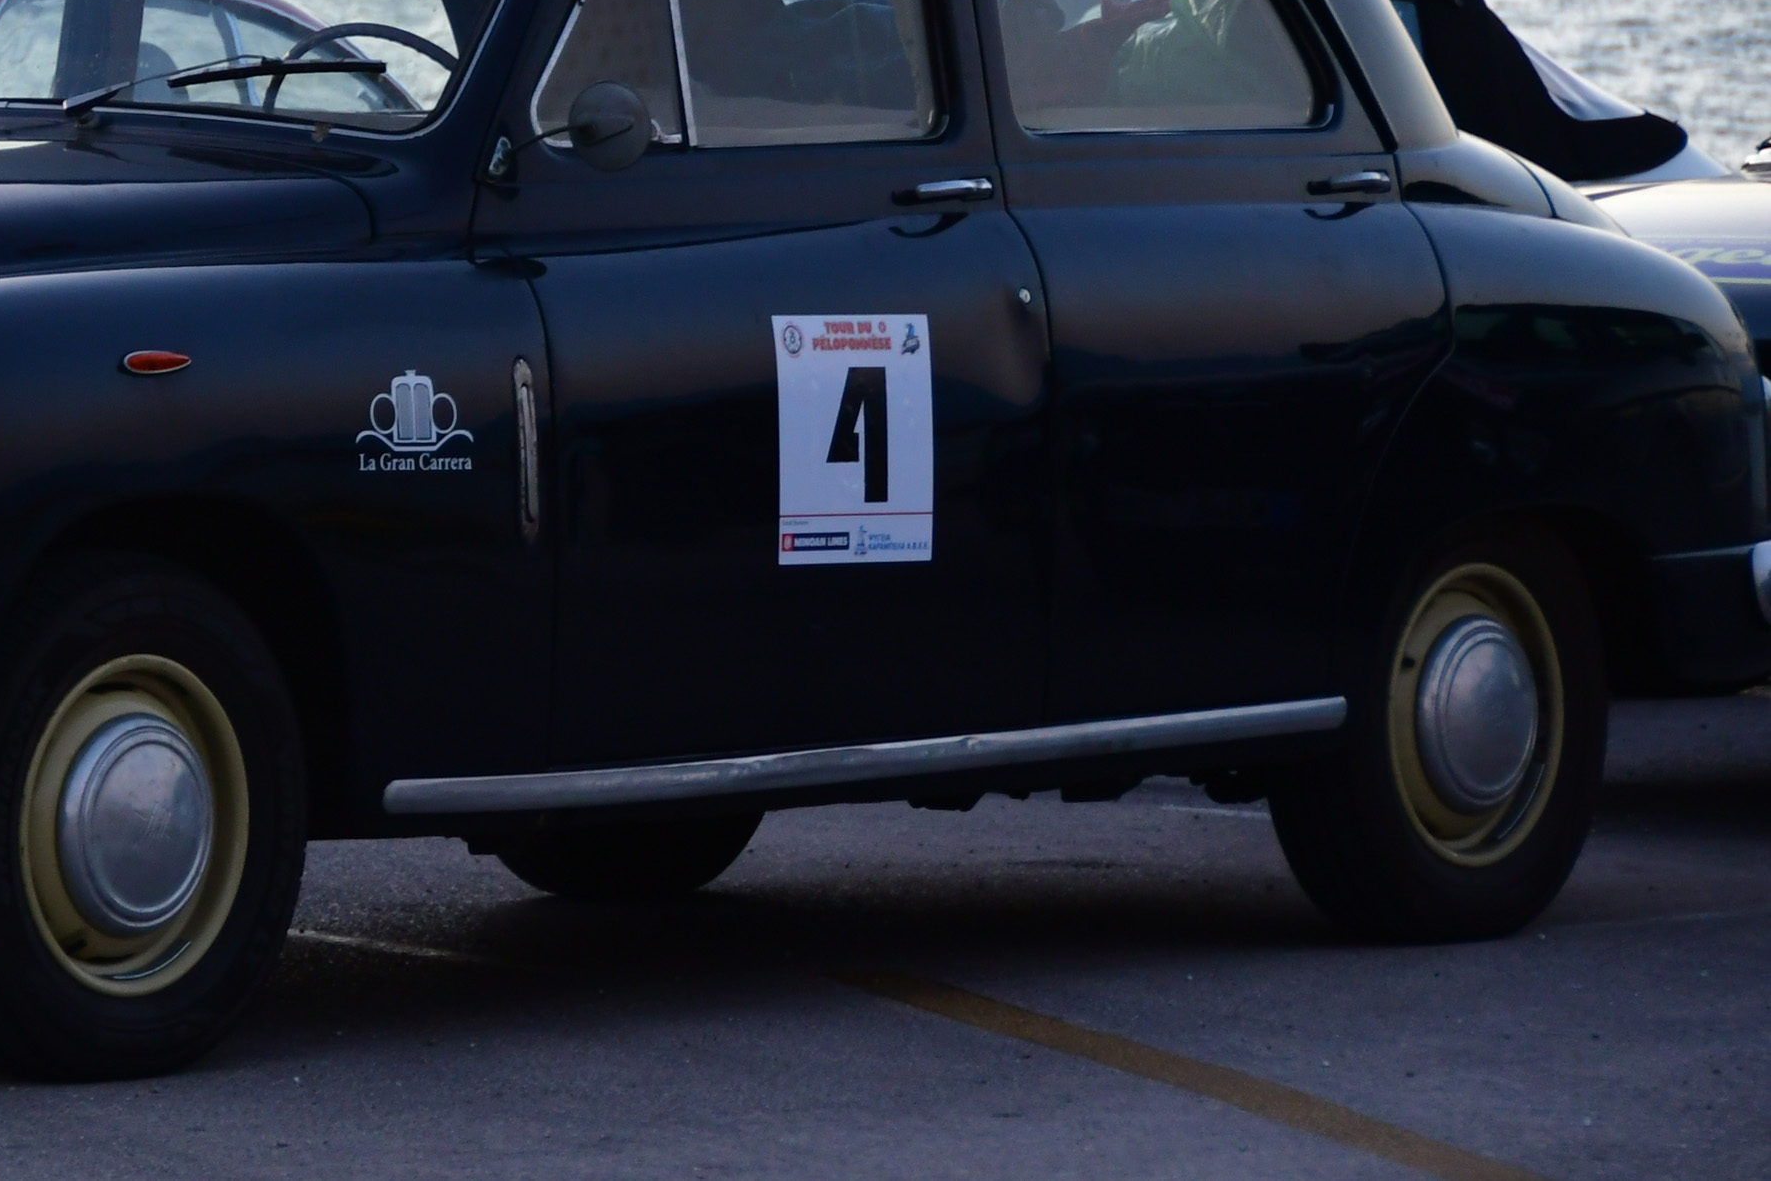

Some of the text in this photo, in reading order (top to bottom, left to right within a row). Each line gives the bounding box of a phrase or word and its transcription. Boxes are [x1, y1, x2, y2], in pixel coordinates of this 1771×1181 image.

[824, 321, 871, 334] TOUR DU
[825, 366, 889, 503] 4
[358, 452, 473, 471] La Gran Carrera
[793, 535, 849, 548] MINOAN LINES
